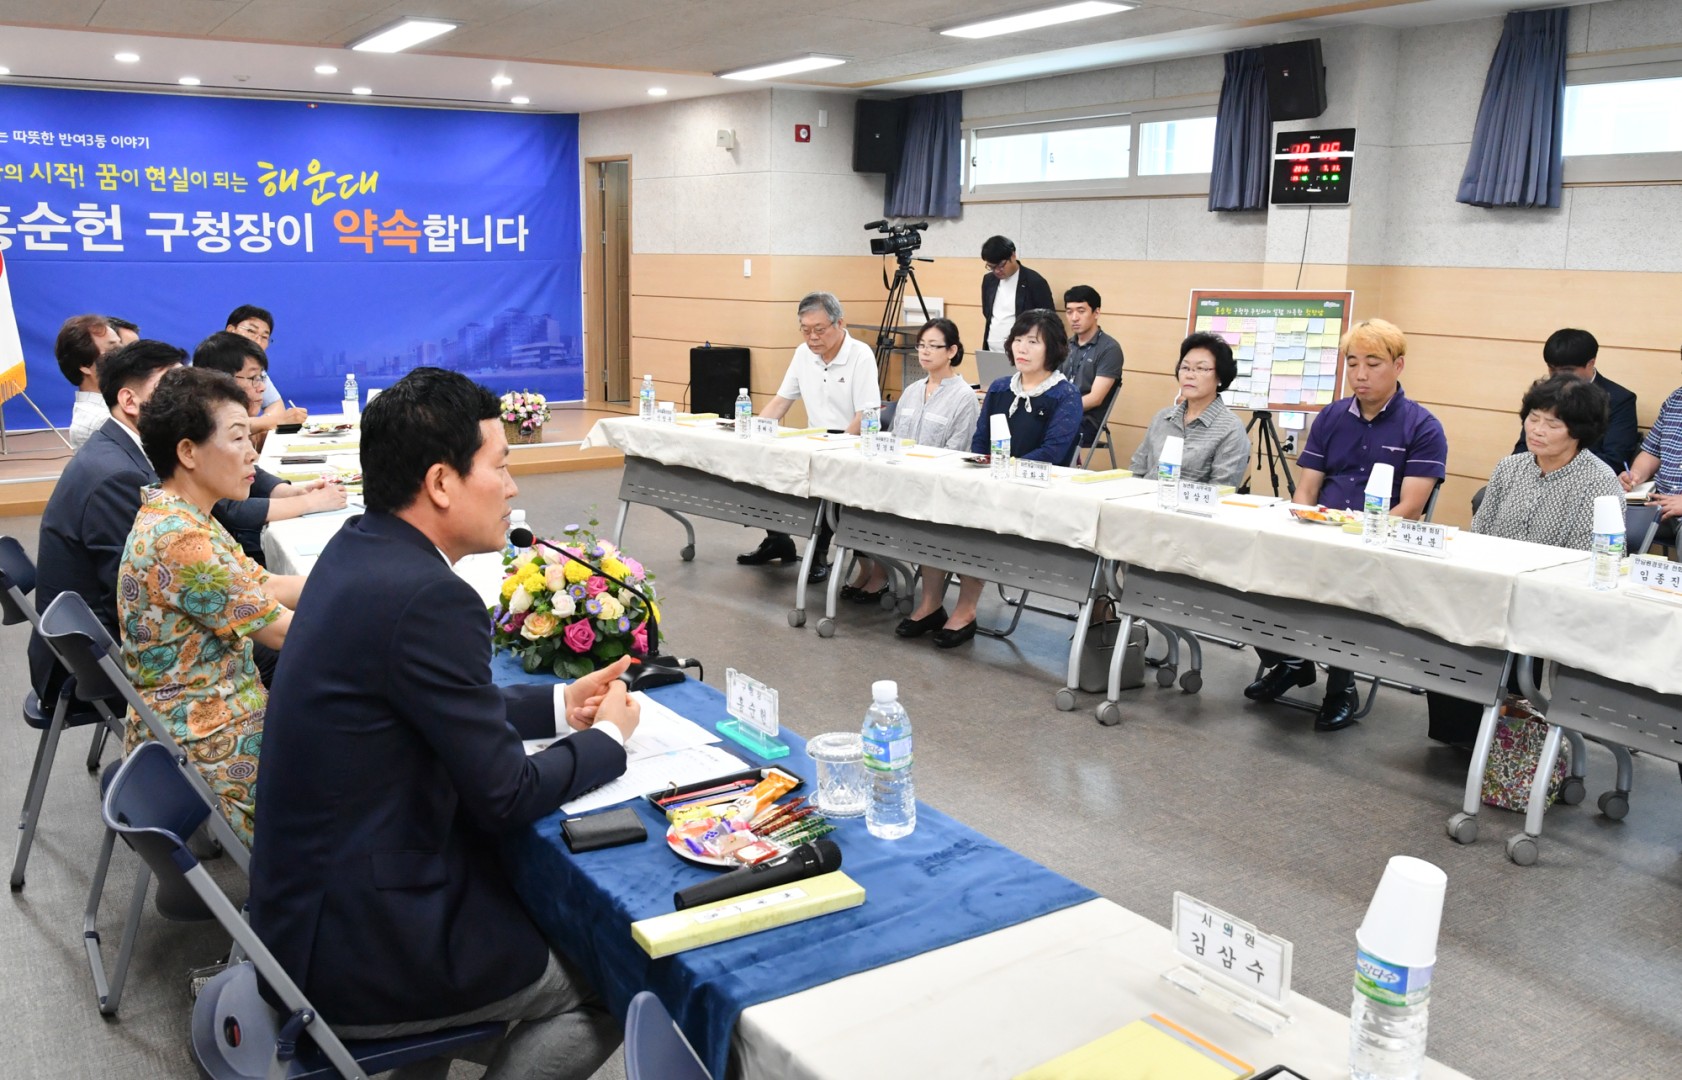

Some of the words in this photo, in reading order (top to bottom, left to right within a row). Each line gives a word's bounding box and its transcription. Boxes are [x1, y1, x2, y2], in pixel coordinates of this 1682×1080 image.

[12, 130, 55, 146] 따뜻한
[58, 132, 107, 149] 반여3동
[110, 136, 150, 150] 이야기
[0, 163, 23, 183] 의
[29, 162, 85, 190] 시작!
[95, 163, 139, 191] 꿈이
[145, 166, 208, 193] 현실이
[212, 171, 249, 193] 되는
[257, 158, 379, 206] 해운대
[145, 210, 314, 254] 구청장이
[333, 208, 530, 254] 약속합니다
[1201, 912, 1256, 949] 시의원
[1189, 931, 1266, 984] 김삼수
